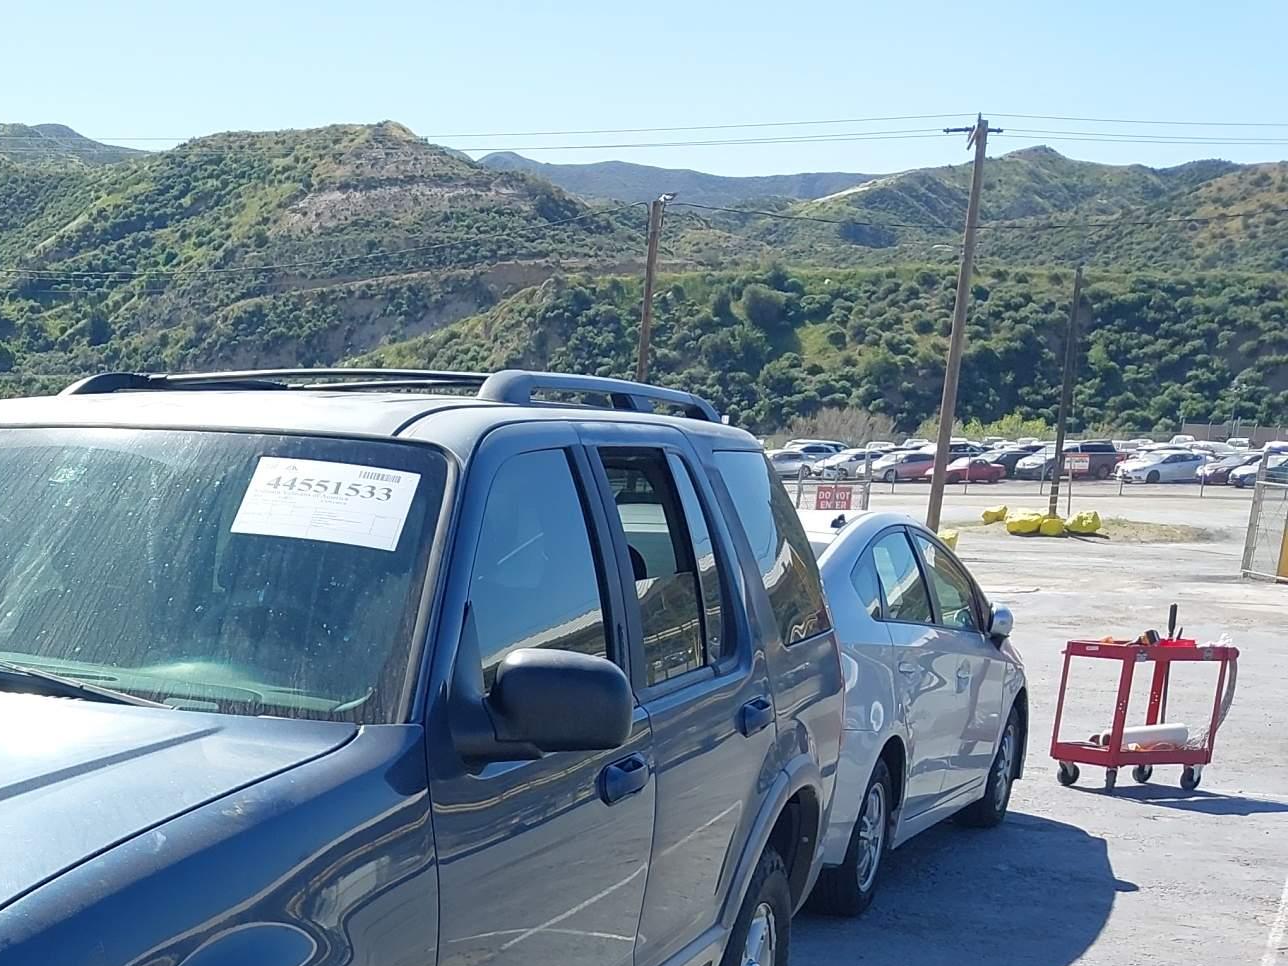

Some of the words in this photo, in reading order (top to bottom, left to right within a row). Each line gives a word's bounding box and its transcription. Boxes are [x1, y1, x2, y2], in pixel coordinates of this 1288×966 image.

[266, 475, 393, 503] 44551533
[818, 491, 831, 500] DO
[820, 501, 847, 509] ENER
